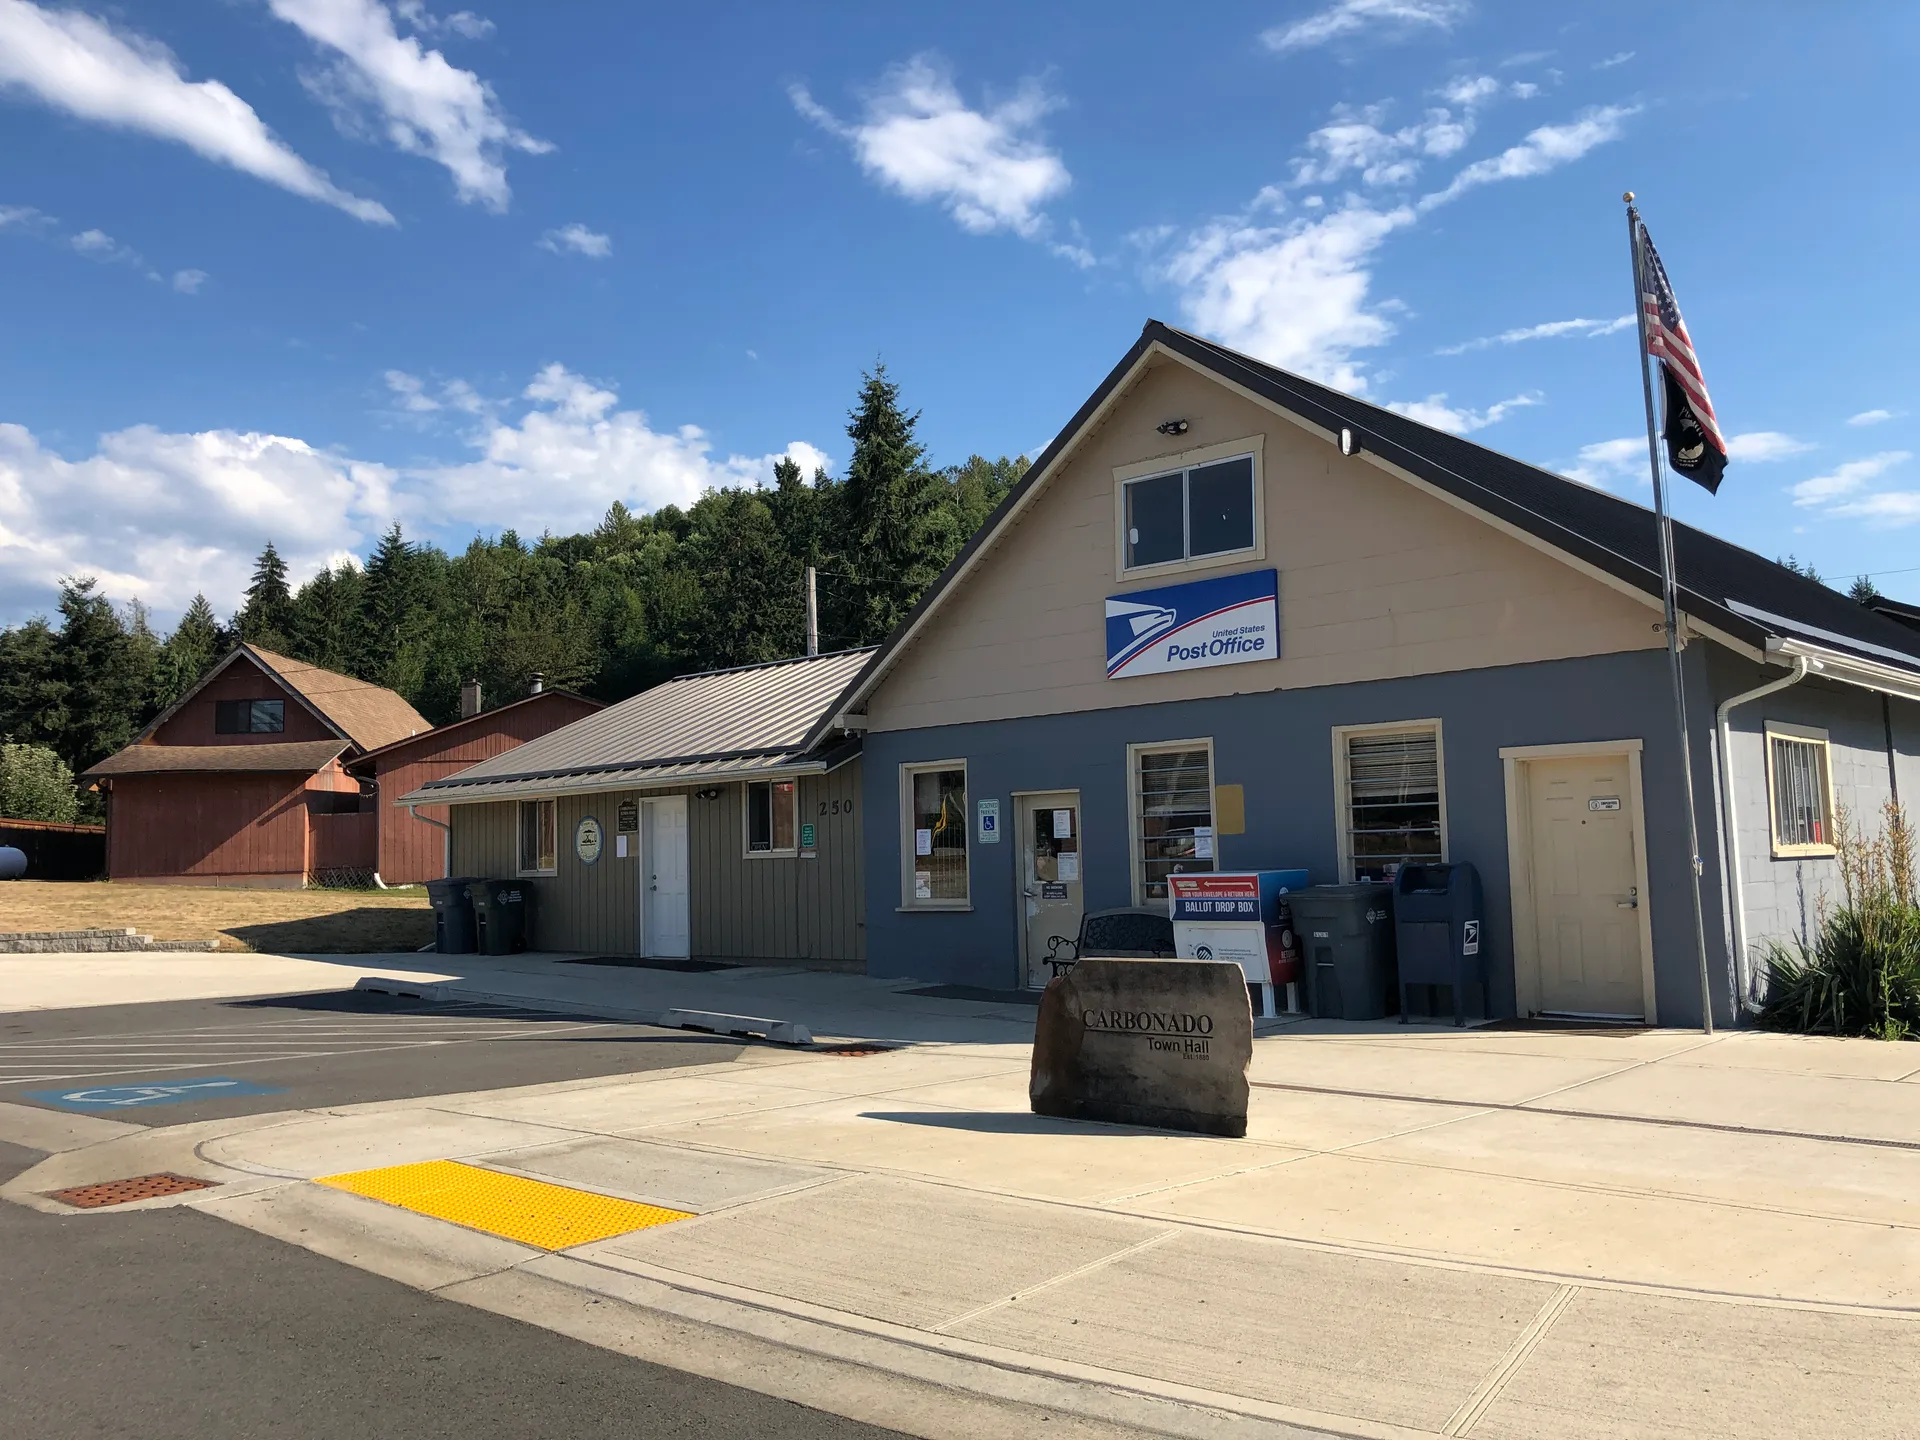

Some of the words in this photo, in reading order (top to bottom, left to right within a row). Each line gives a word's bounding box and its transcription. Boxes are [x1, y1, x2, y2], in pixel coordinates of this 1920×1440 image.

[1212, 628, 1238, 638] United
[1239, 624, 1265, 635] States
[1167, 640, 1208, 662] Post
[1209, 636, 1265, 656] Office
[819, 799, 852, 816] 250
[1185, 902, 1212, 912] BALLOT
[1215, 902, 1235, 912] DROP
[1238, 902, 1254, 912] BOX
[1082, 1009, 1213, 1034] CARBONADO
[1146, 1037, 1180, 1052] Town
[1184, 1039, 1209, 1054] Hall
